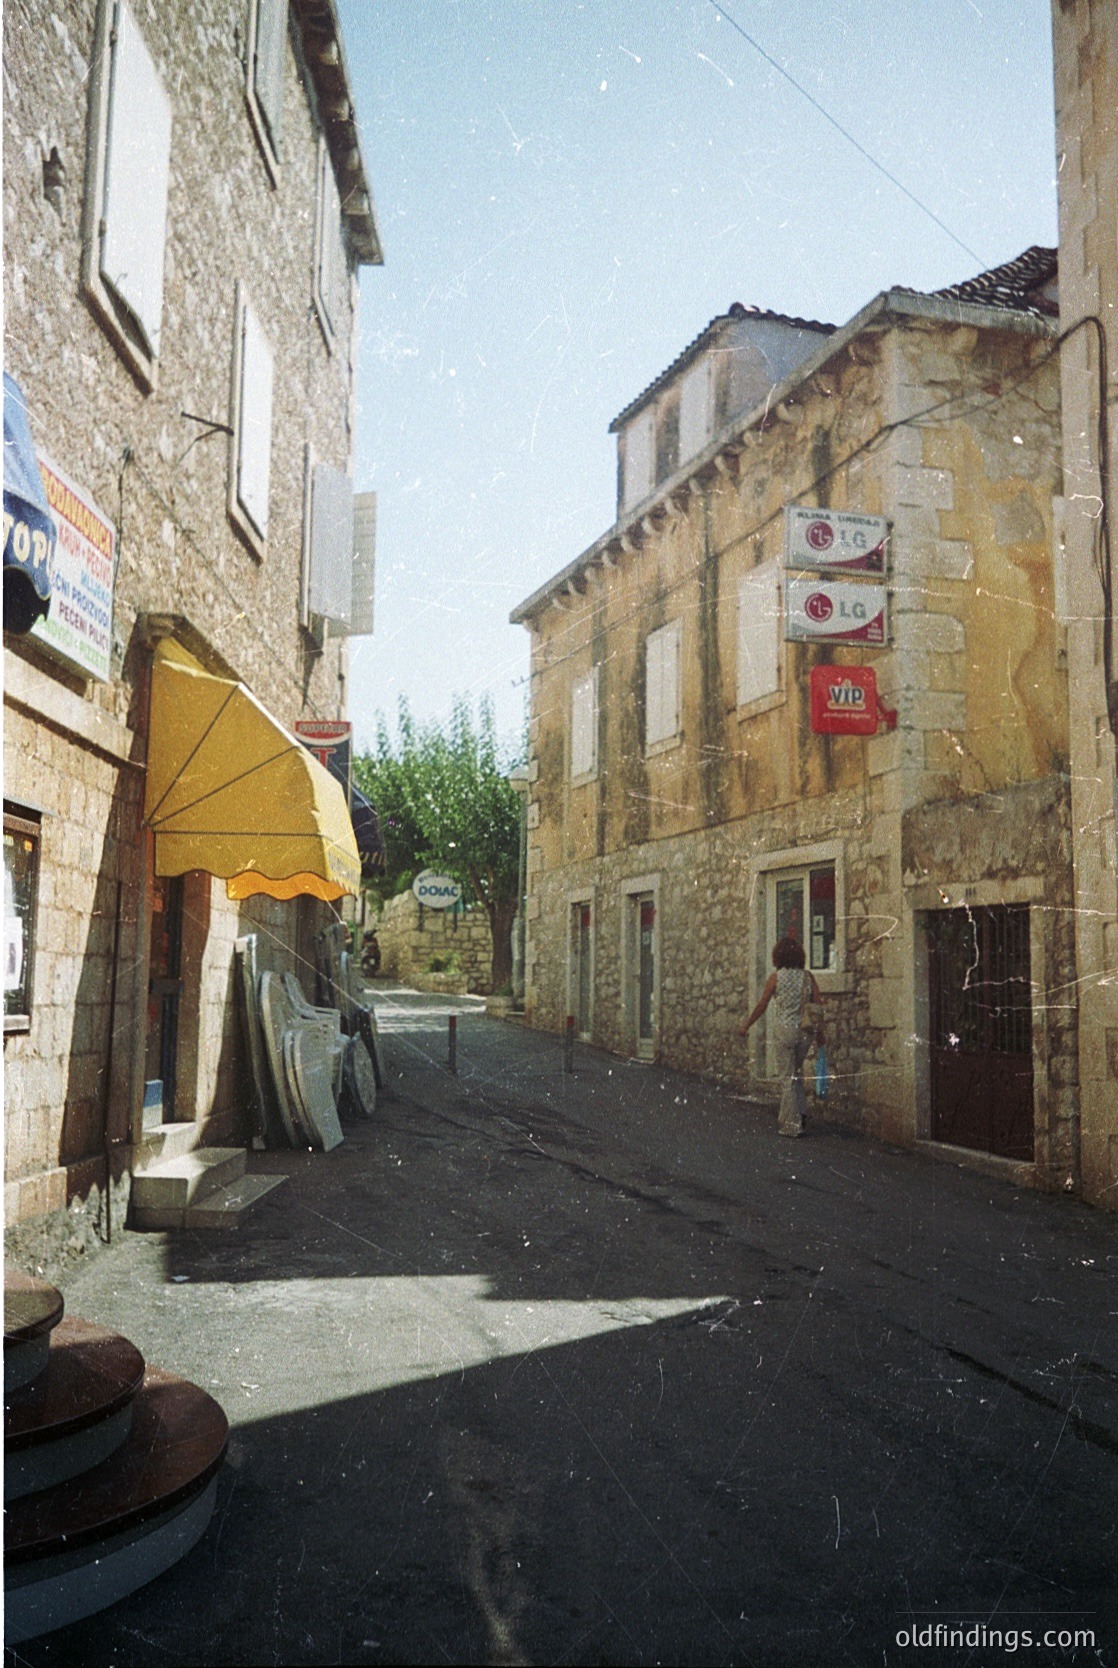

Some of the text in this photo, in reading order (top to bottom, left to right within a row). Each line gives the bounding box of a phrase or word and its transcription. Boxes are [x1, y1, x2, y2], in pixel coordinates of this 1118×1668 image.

[840, 529, 867, 549] LG
[840, 601, 867, 619] LG
[831, 686, 863, 704] VIP
[419, 885, 458, 897] DOLAC
